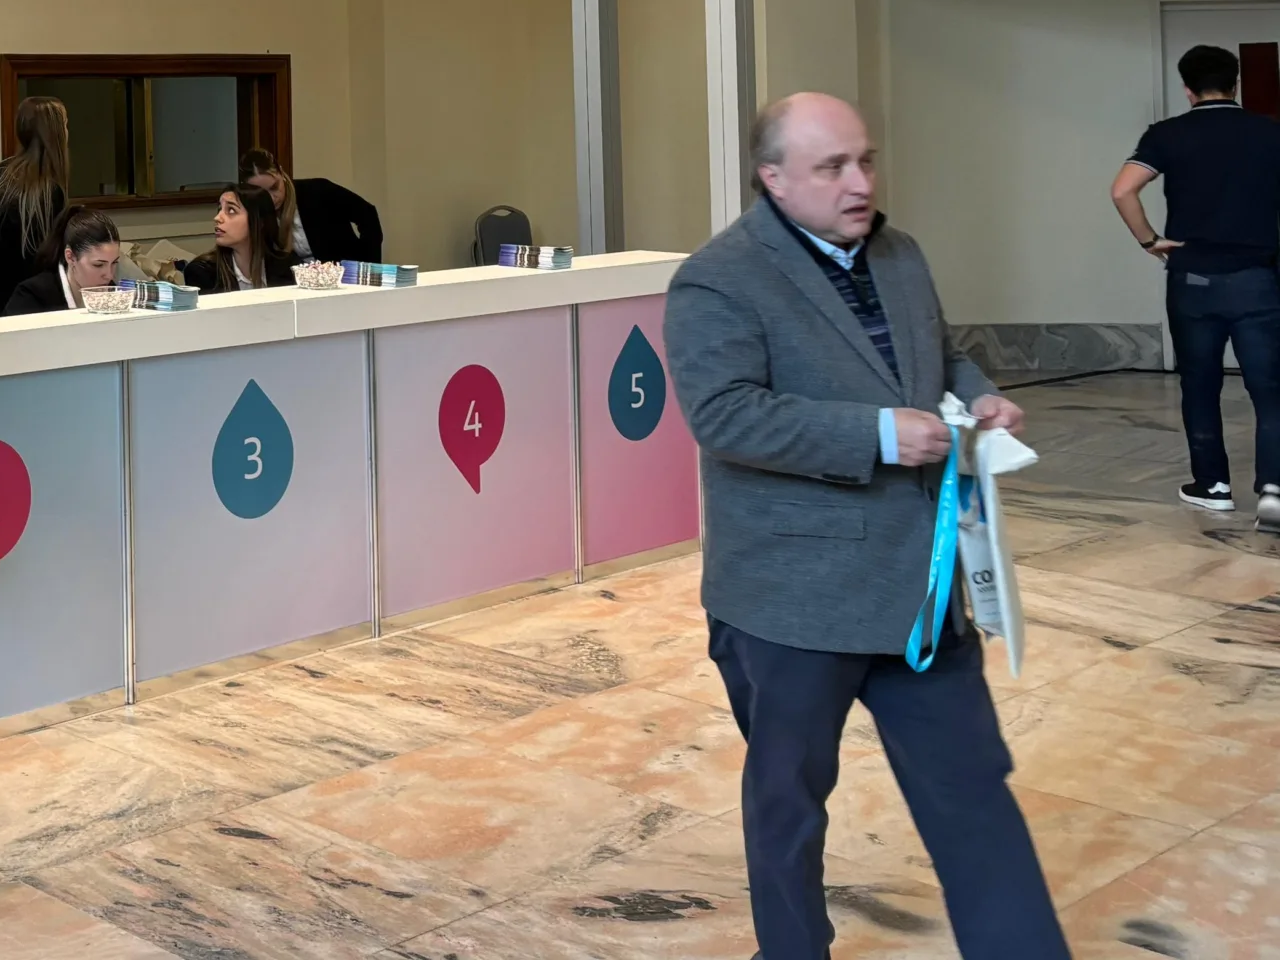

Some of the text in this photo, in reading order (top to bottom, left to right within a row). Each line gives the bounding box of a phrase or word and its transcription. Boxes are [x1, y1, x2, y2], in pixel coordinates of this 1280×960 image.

[630, 372, 646, 409] 5
[463, 400, 483, 437] 4
[243, 436, 263, 480] 3
